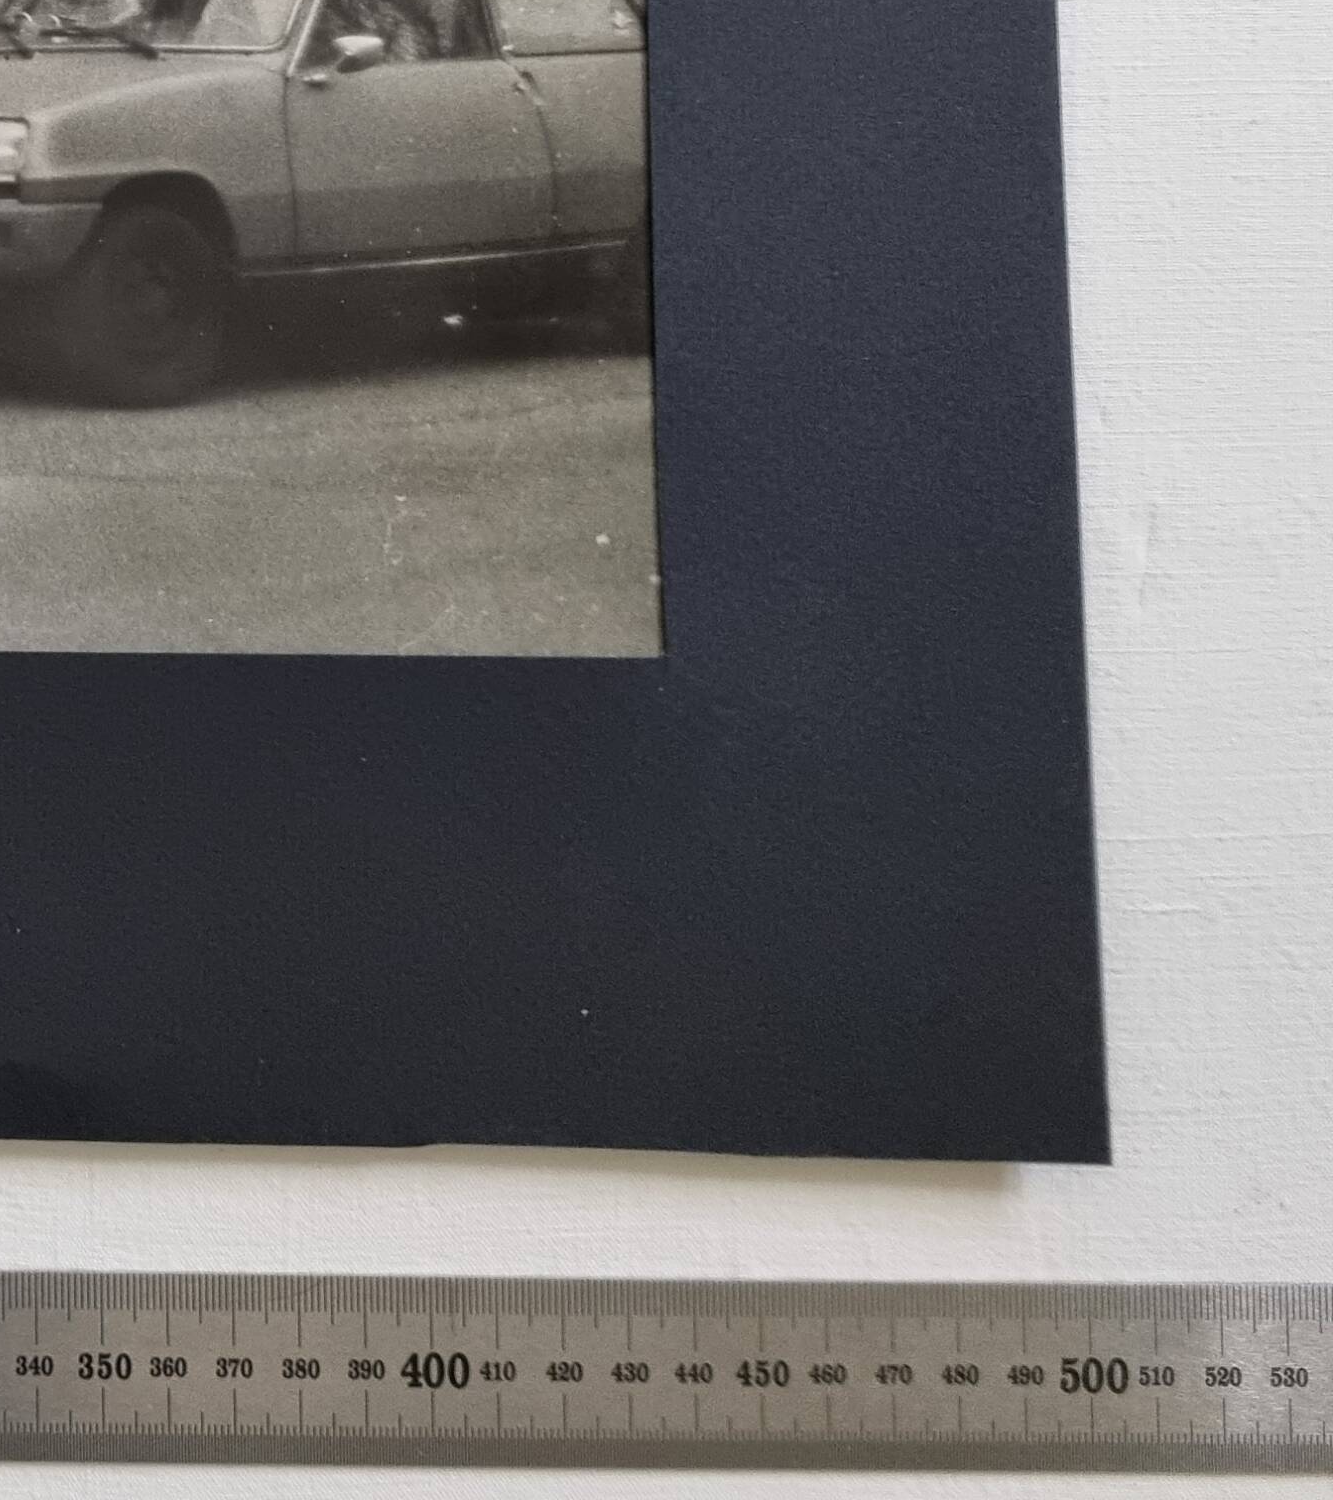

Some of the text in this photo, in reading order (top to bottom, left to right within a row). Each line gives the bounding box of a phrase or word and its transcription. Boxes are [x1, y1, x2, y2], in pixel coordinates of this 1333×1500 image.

[15, 1355, 54, 1377] 340
[78, 1352, 133, 1381] 350
[149, 1356, 188, 1378] 360
[215, 1357, 254, 1379] 370
[282, 1357, 321, 1380] 380
[347, 1358, 386, 1381] 390
[400, 1351, 471, 1390] 400
[479, 1360, 517, 1382] 410
[545, 1361, 584, 1383] 420
[610, 1361, 650, 1384] 430
[674, 1362, 714, 1384] 440
[735, 1359, 791, 1388] 450
[808, 1363, 848, 1386] 460
[874, 1363, 913, 1386] 470
[941, 1363, 980, 1386] 480
[1007, 1364, 1045, 1386] 490
[1059, 1356, 1130, 1395] 500
[1138, 1365, 1176, 1387] 510
[1204, 1366, 1243, 1388] 520
[1269, 1366, 1309, 1388] 530
